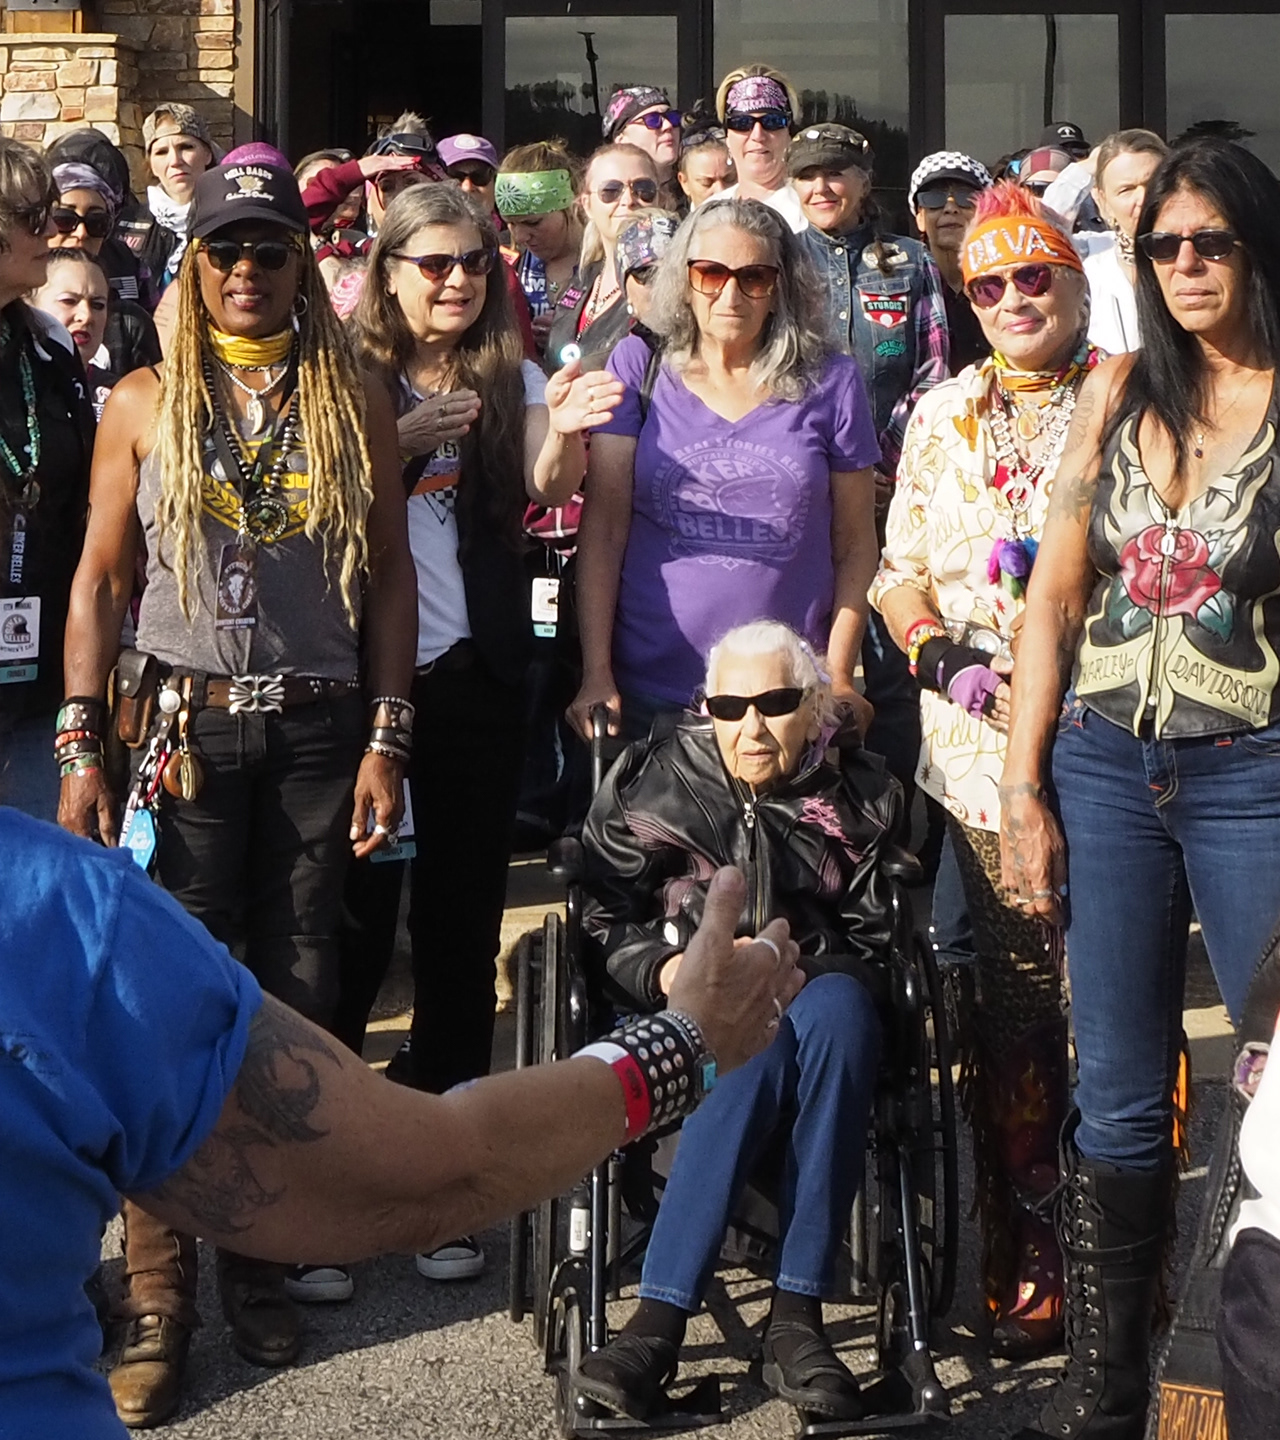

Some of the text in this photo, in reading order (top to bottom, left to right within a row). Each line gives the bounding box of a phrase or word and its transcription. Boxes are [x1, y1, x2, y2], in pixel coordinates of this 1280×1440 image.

[967, 225, 1058, 272] DIVA
[867, 301, 902, 311] STURGIS
[10, 531, 26, 584] BIKER BELLES
